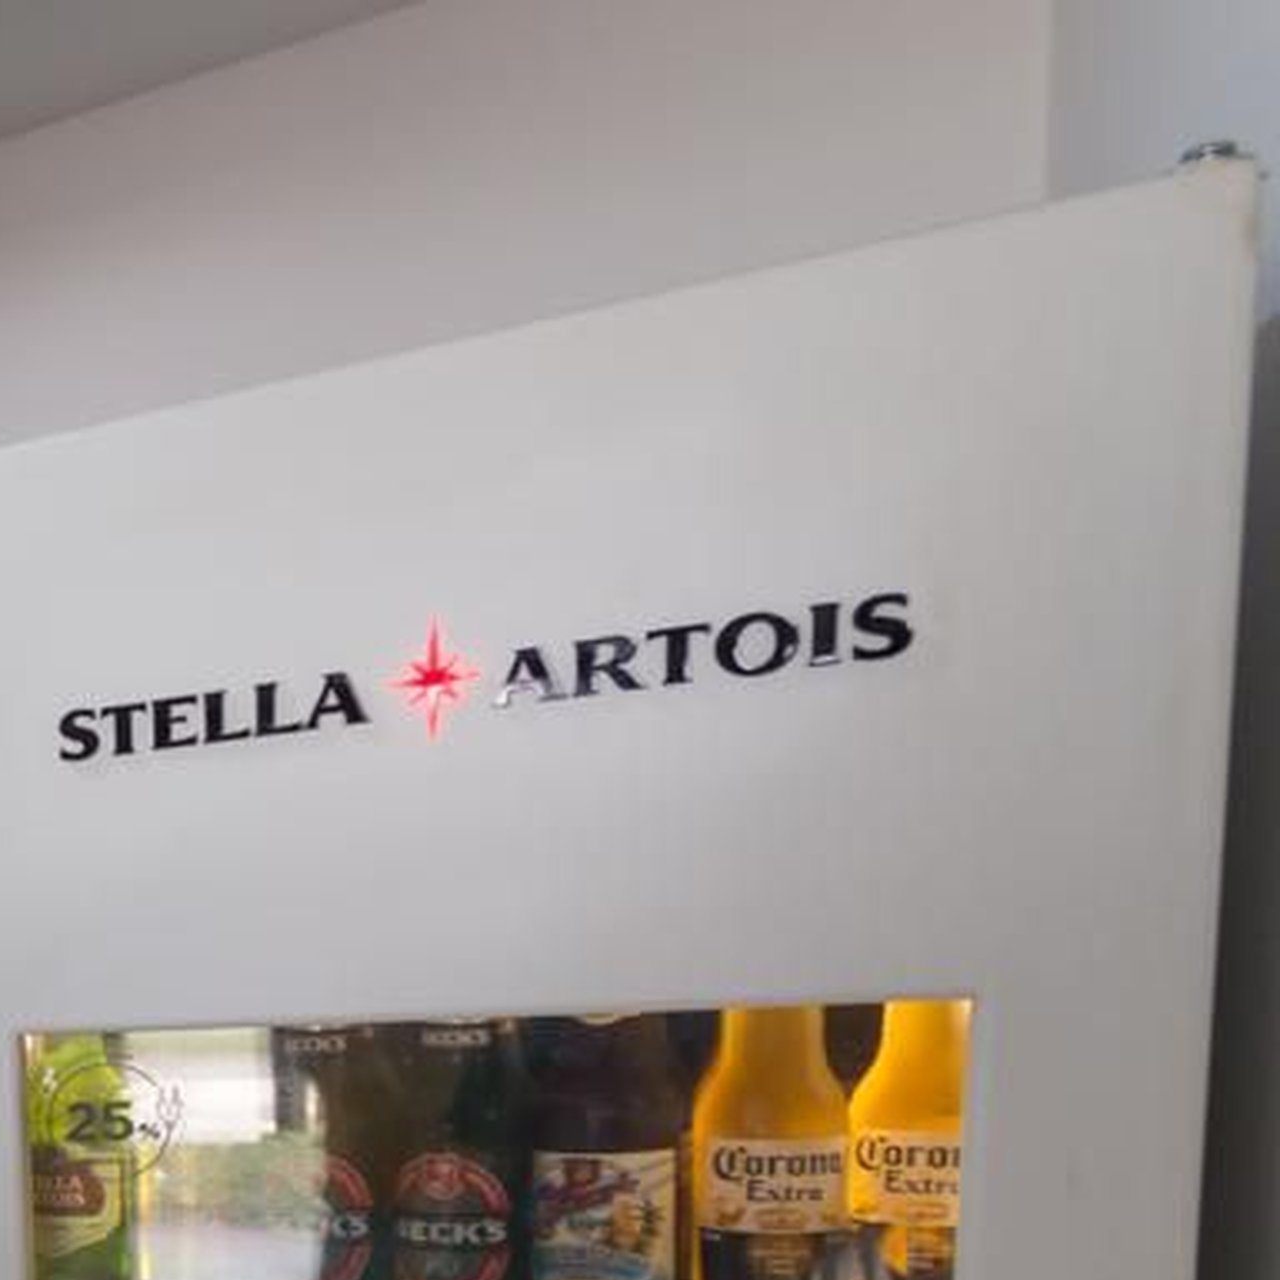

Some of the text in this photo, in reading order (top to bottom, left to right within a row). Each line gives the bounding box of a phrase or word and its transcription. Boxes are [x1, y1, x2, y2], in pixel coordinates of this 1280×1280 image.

[59, 592, 915, 762] STELLA ARTOIS
[746, 1179, 823, 1203] Extra
